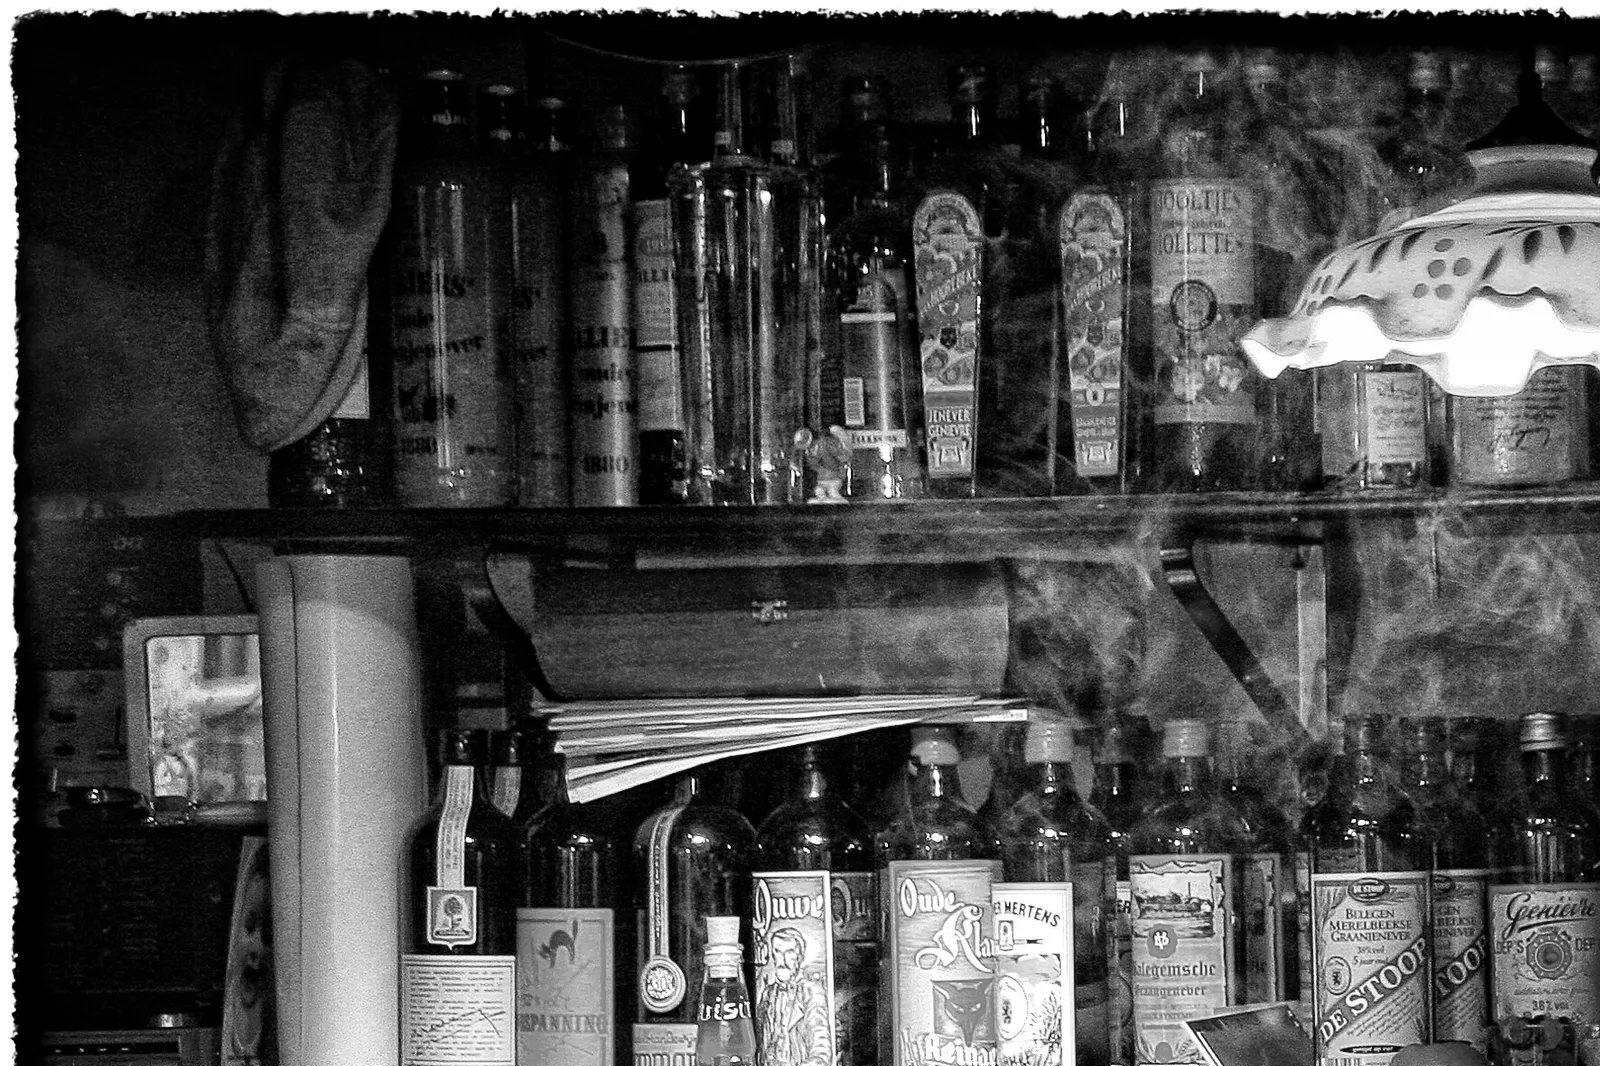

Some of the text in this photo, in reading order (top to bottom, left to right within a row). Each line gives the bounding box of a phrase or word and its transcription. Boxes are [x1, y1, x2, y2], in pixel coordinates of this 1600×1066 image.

[928, 409, 972, 423] JENEVER
[1004, 900, 1061, 928] MERTENS
[1345, 908, 1395, 920] BELEGEN
[1329, 920, 1412, 931] MERELBEEKSE
[1319, 1009, 1349, 1042] DE
[1346, 937, 1426, 1016] STOOP
